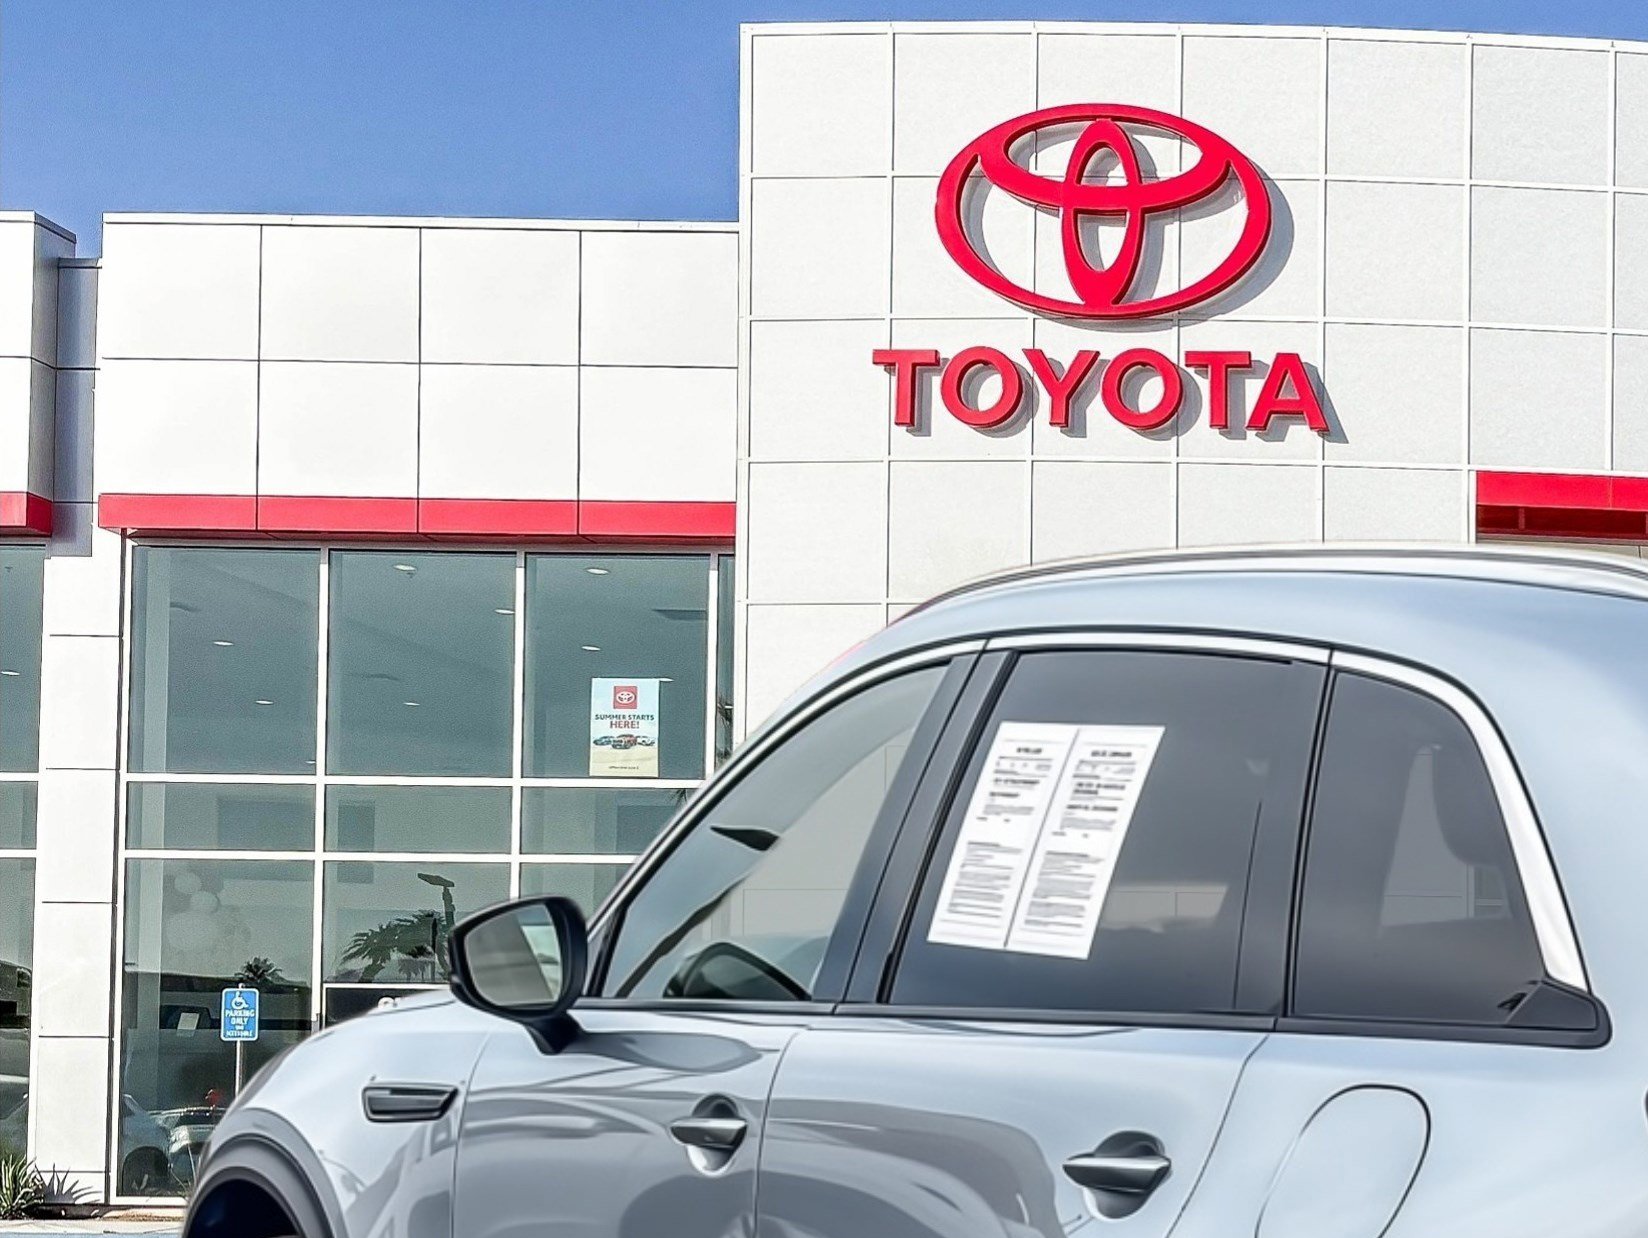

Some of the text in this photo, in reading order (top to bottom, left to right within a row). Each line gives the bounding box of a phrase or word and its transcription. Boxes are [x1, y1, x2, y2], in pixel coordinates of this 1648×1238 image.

[872, 345, 1329, 432] TOYOTA
[610, 720, 640, 729] HERE!
[225, 1009, 255, 1017] PARKING
[230, 1017, 248, 1025] ONLY
